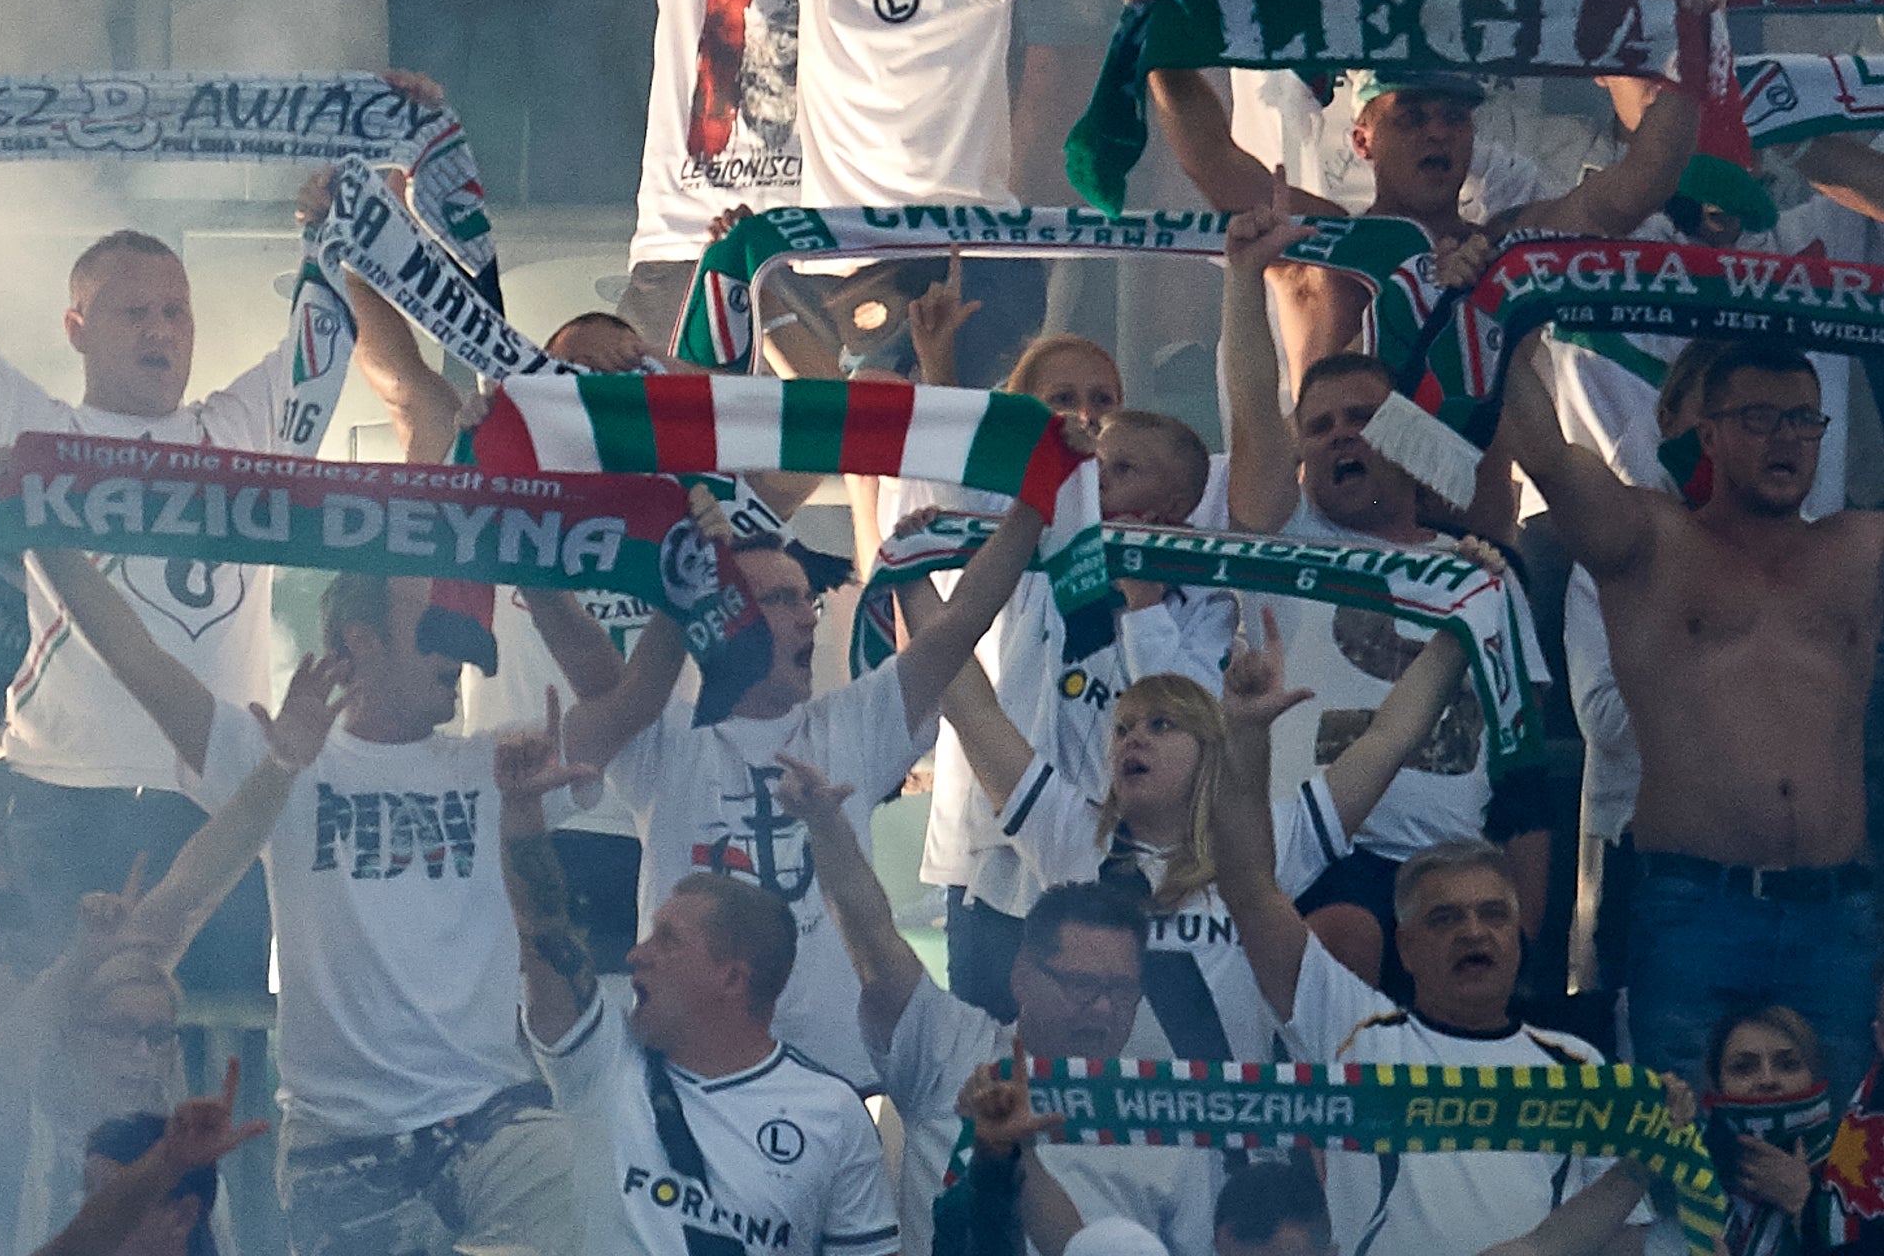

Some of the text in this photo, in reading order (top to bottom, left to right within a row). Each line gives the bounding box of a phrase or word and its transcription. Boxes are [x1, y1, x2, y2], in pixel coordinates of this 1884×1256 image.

[1491, 250, 1884, 314] LEGIA WAR
[1715, 309, 1771, 331] JEST
[57, 442, 160, 475] Nigdy
[168, 451, 220, 471] nie
[19, 471, 628, 577] KAZIU DEYNA
[1115, 1086, 1356, 1126] WARSZAWA
[1404, 1097, 1497, 1127] ADO
[1515, 1098, 1616, 1130] DEN
